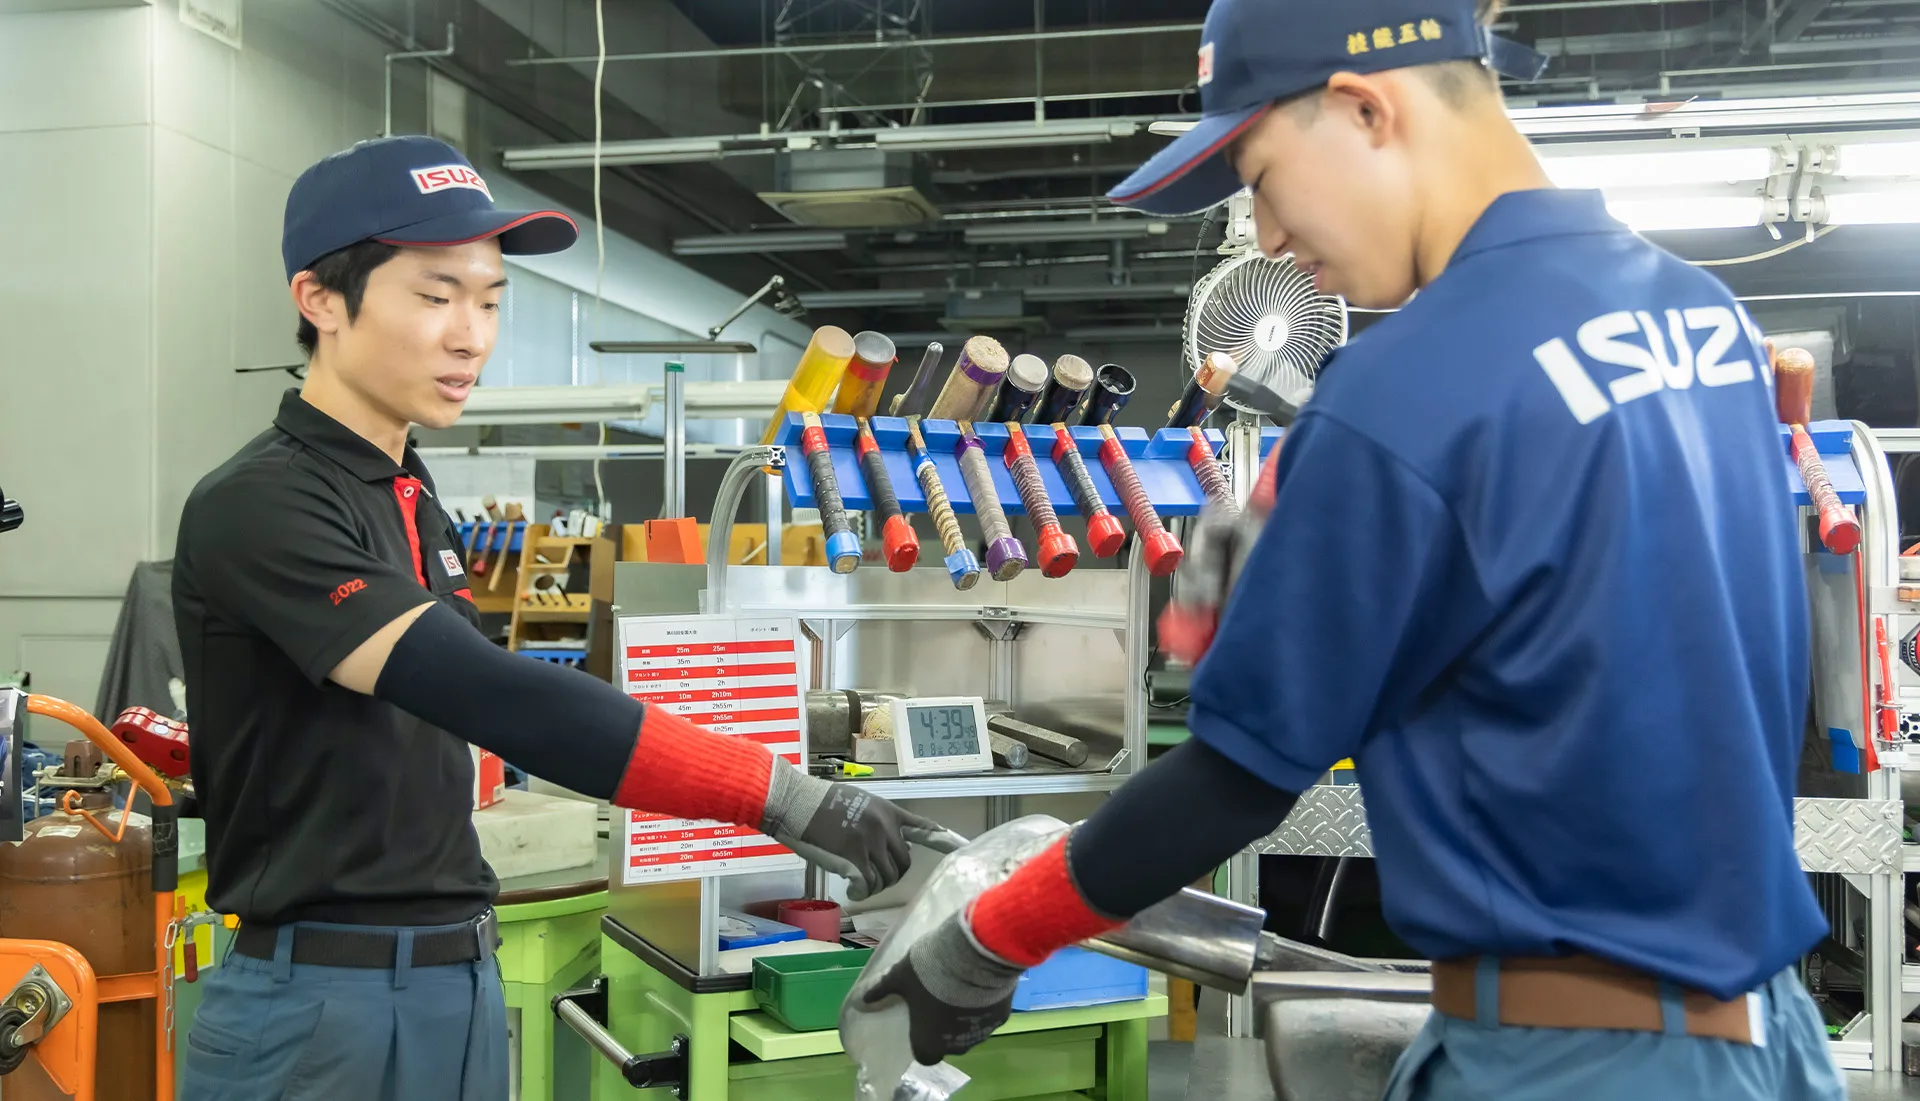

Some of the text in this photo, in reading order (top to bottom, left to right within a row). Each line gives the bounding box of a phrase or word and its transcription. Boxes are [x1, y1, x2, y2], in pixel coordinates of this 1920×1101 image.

[1346, 18, 1442, 55] 技能五輪
[417, 168, 488, 195] ISUZ
[329, 578, 368, 606] 2022
[921, 709, 964, 740] 4:39
